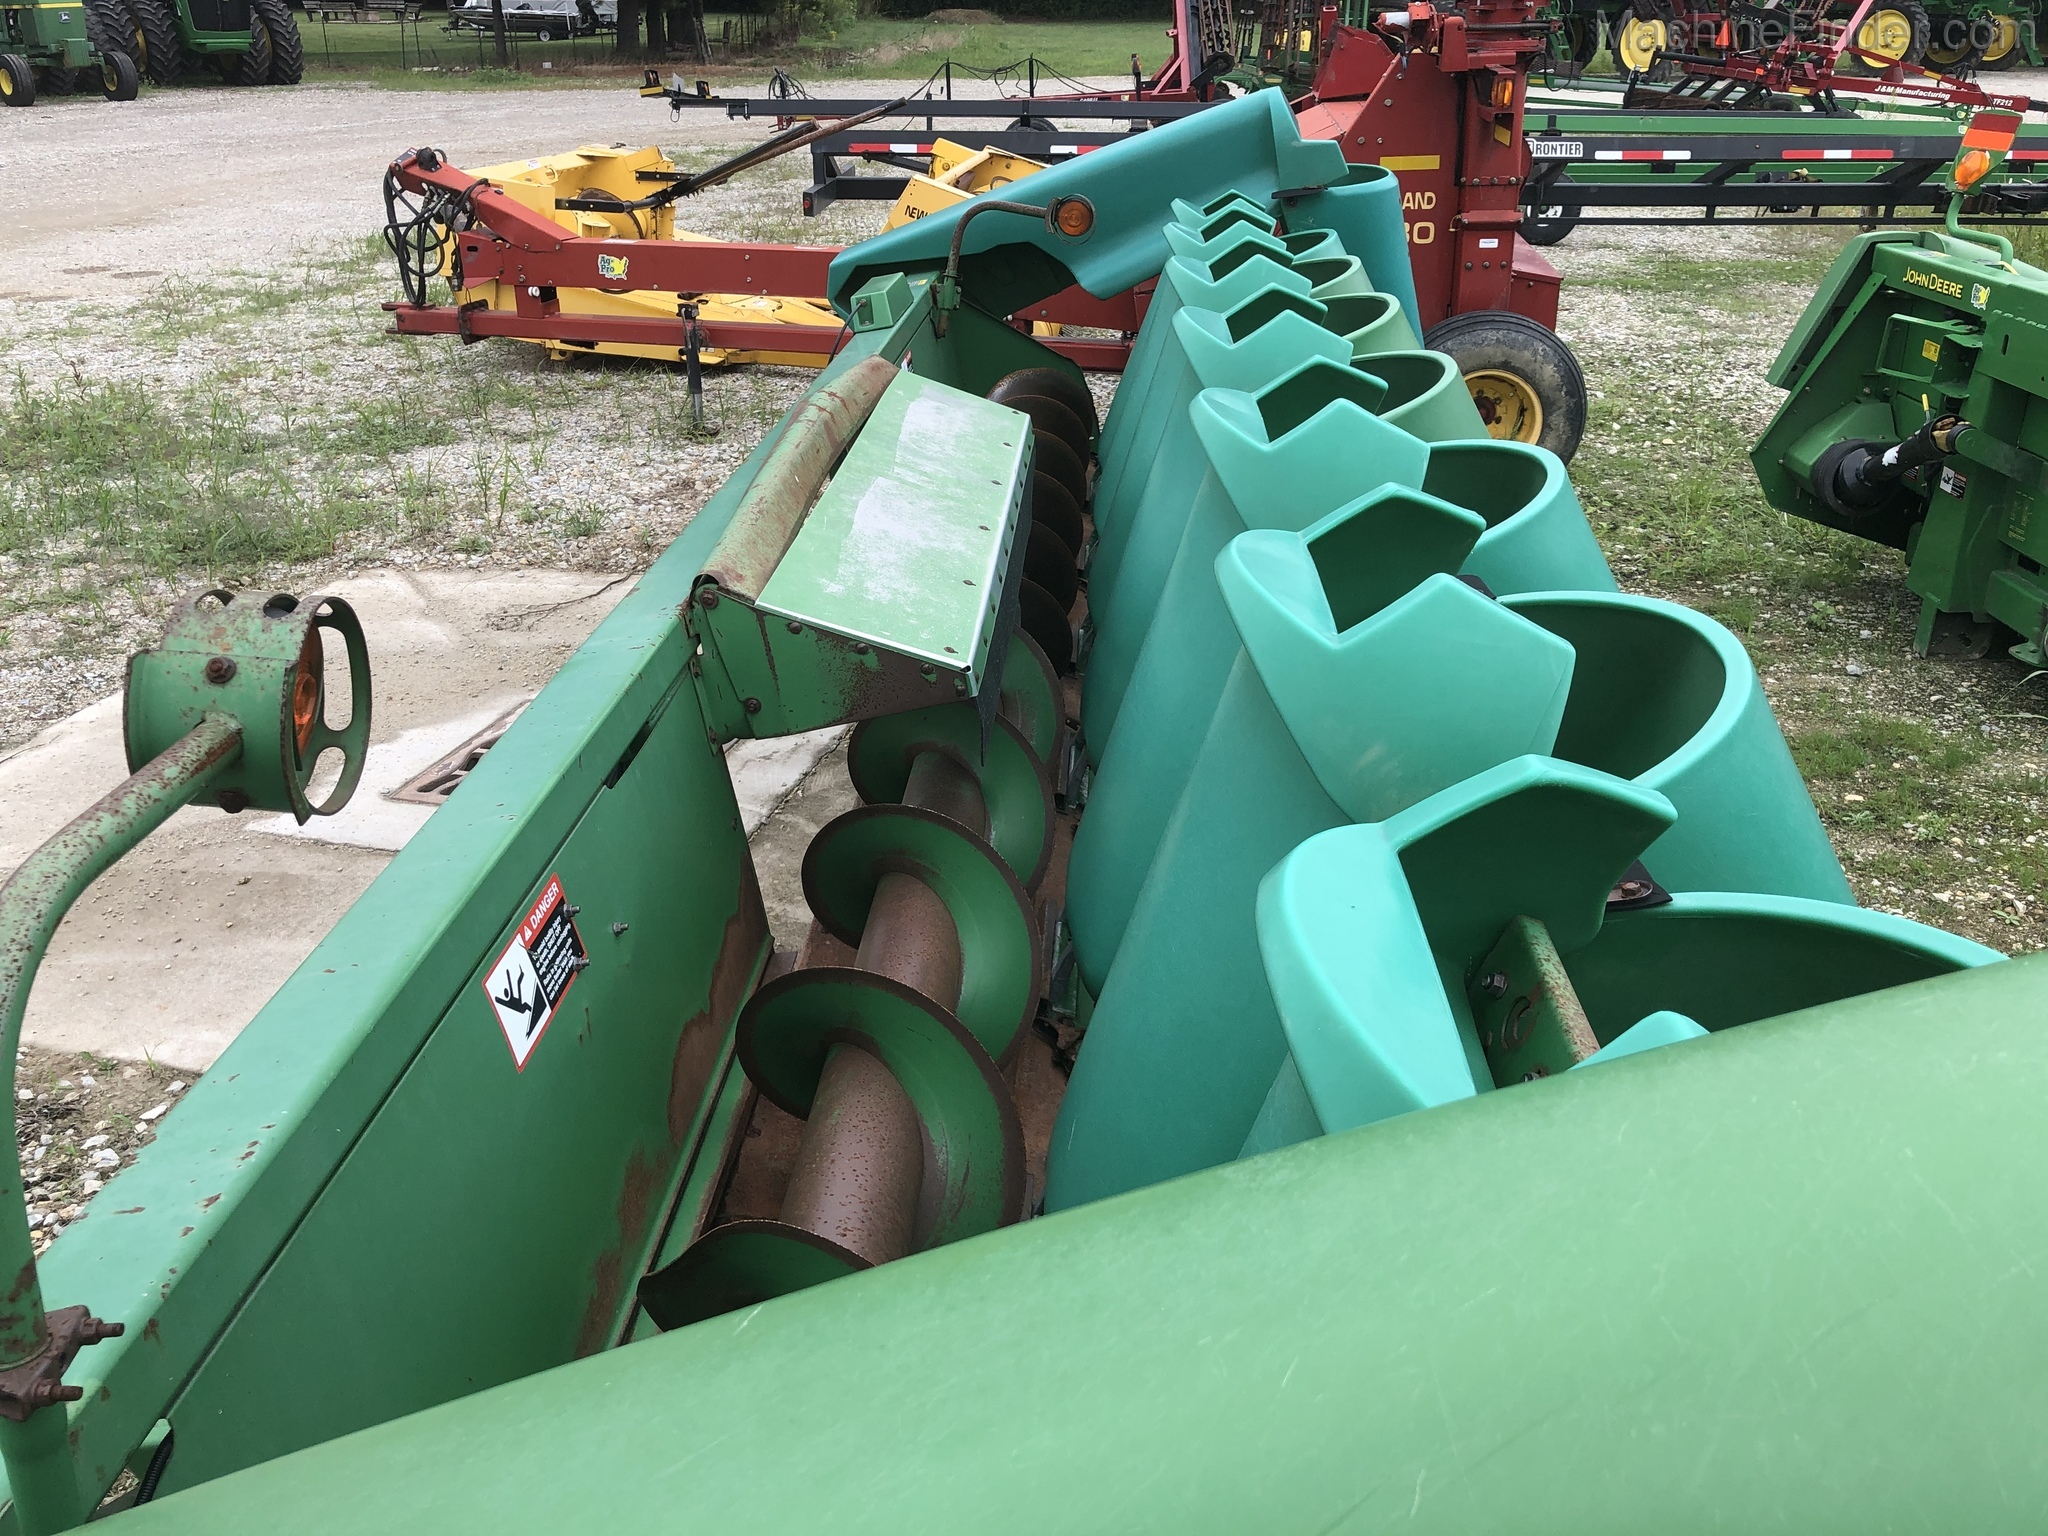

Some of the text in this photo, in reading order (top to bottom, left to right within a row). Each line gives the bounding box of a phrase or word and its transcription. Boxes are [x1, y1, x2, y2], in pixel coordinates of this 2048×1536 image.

[1875, 85, 1951, 100] J&M Manufacturing
[1902, 266, 1963, 299] JOHN DEERE
[530, 882, 559, 930] DANGER
